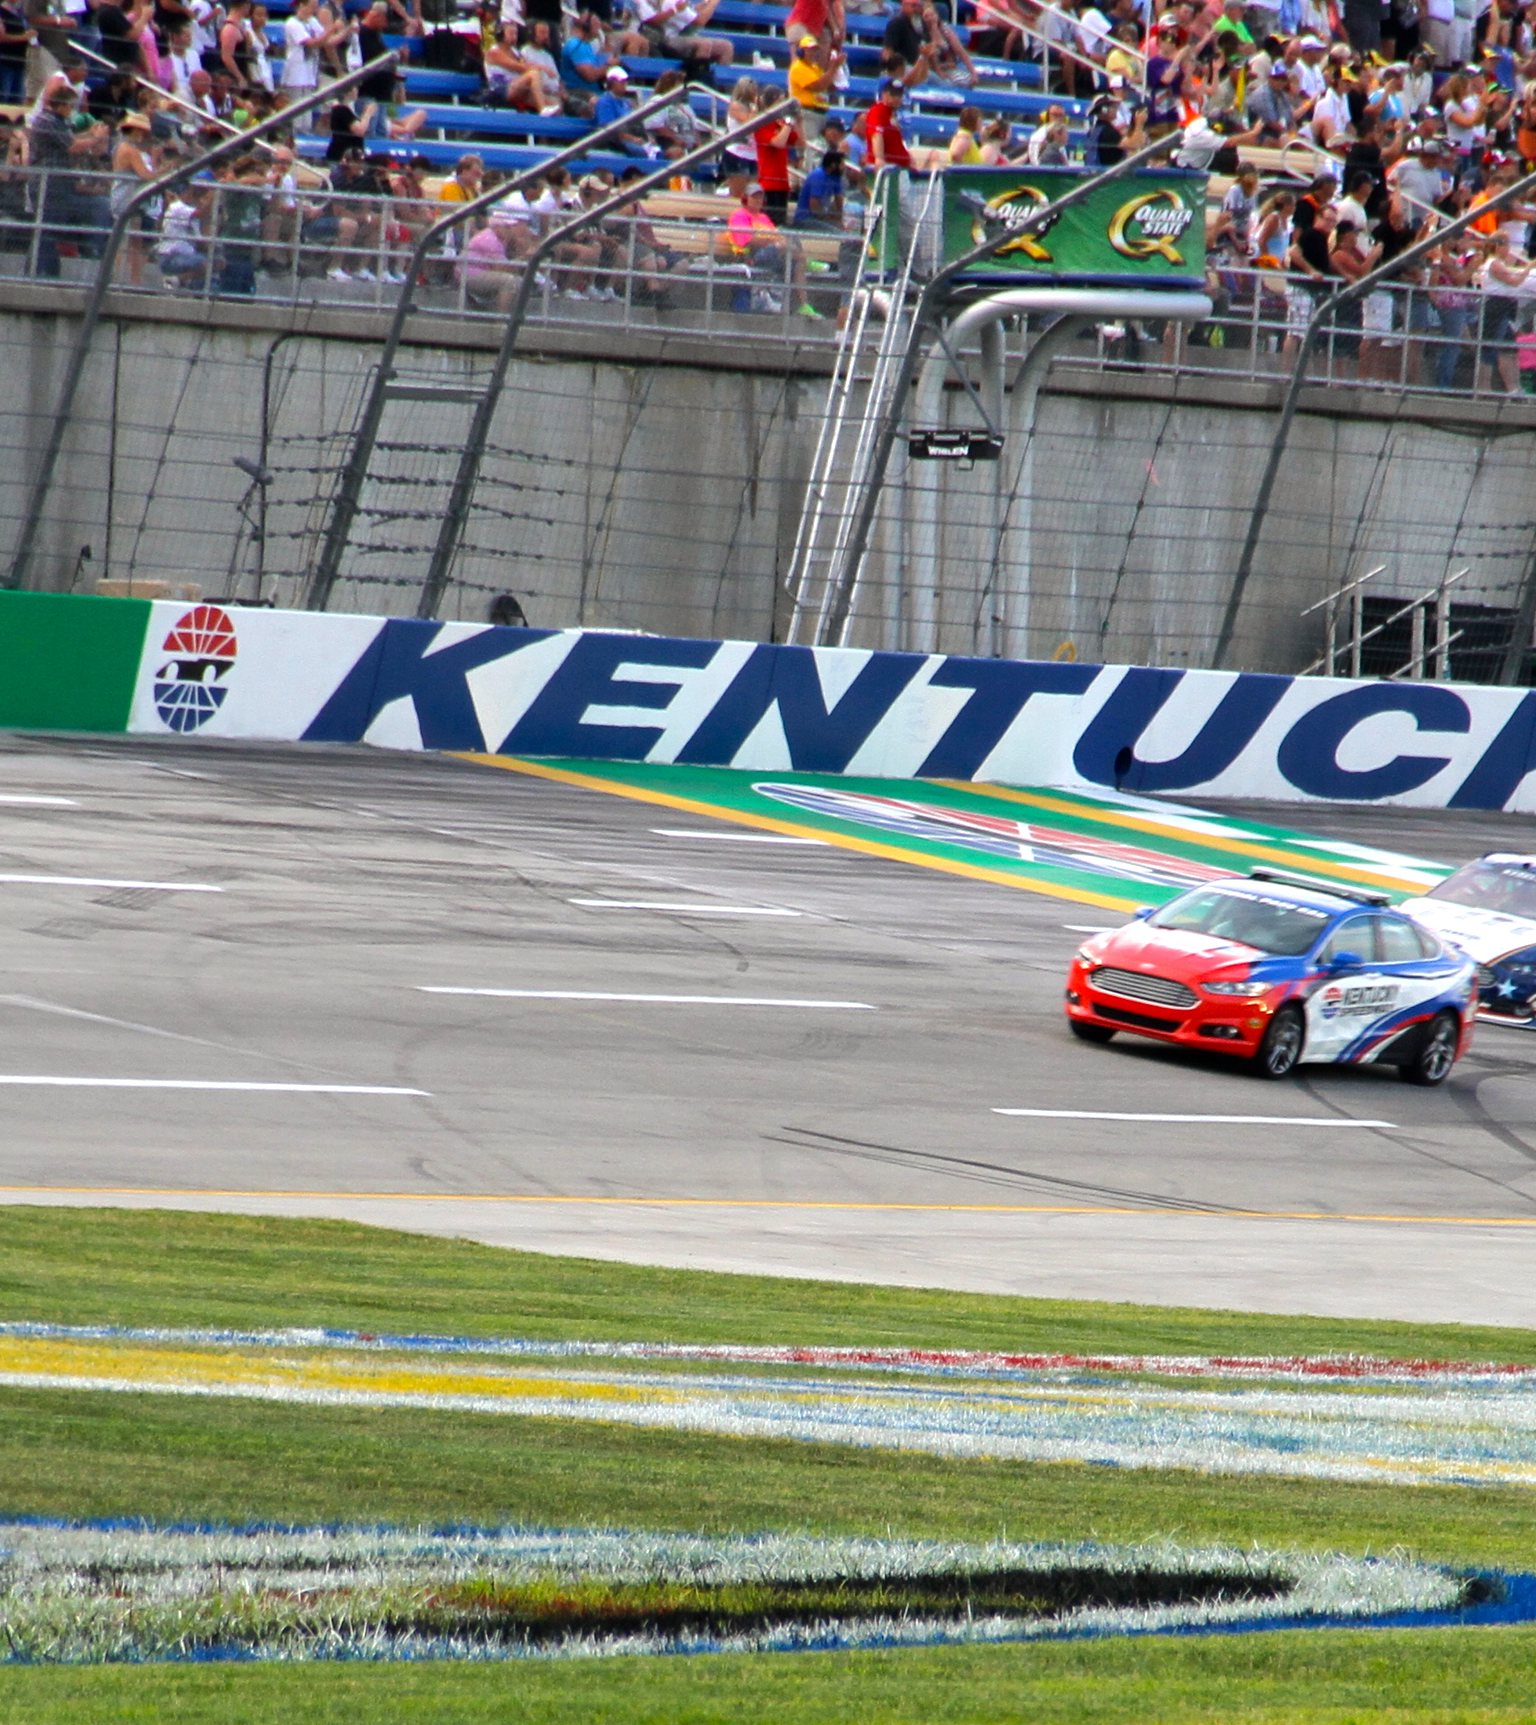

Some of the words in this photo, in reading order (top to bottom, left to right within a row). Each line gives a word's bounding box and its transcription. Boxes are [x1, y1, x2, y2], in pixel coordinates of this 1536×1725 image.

[998, 202, 1058, 221] QUAK
[1134, 204, 1193, 223] QUAKER
[1141, 221, 1182, 236] STATE
